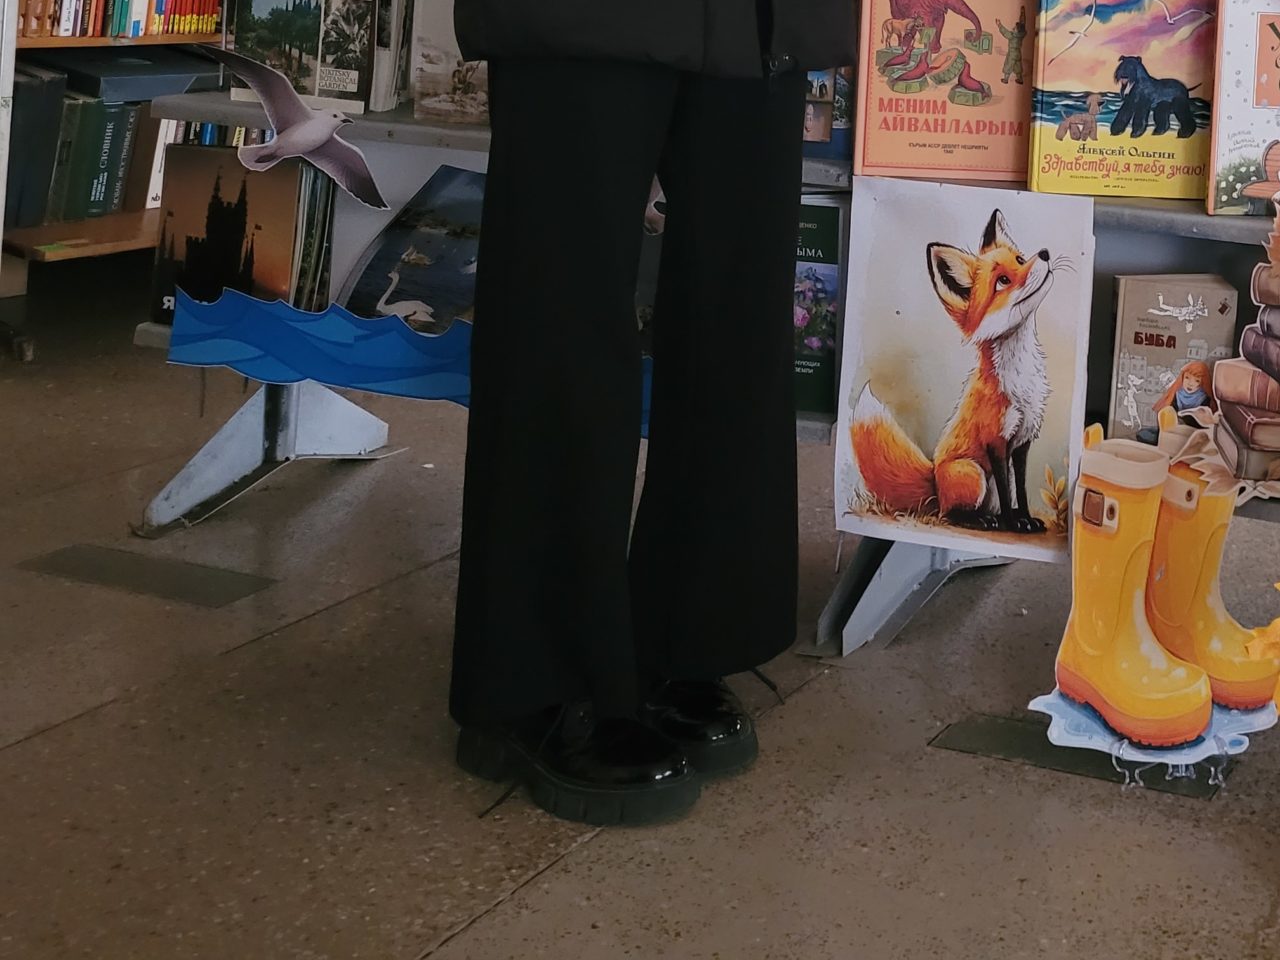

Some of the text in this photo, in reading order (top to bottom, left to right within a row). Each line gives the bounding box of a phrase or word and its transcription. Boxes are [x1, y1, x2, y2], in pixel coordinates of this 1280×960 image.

[878, 97, 947, 115] МЕНИМ
[1041, 154, 1206, 179] Здравствуй, я тебя знаю!
[1134, 331, 1177, 349] БУБА
